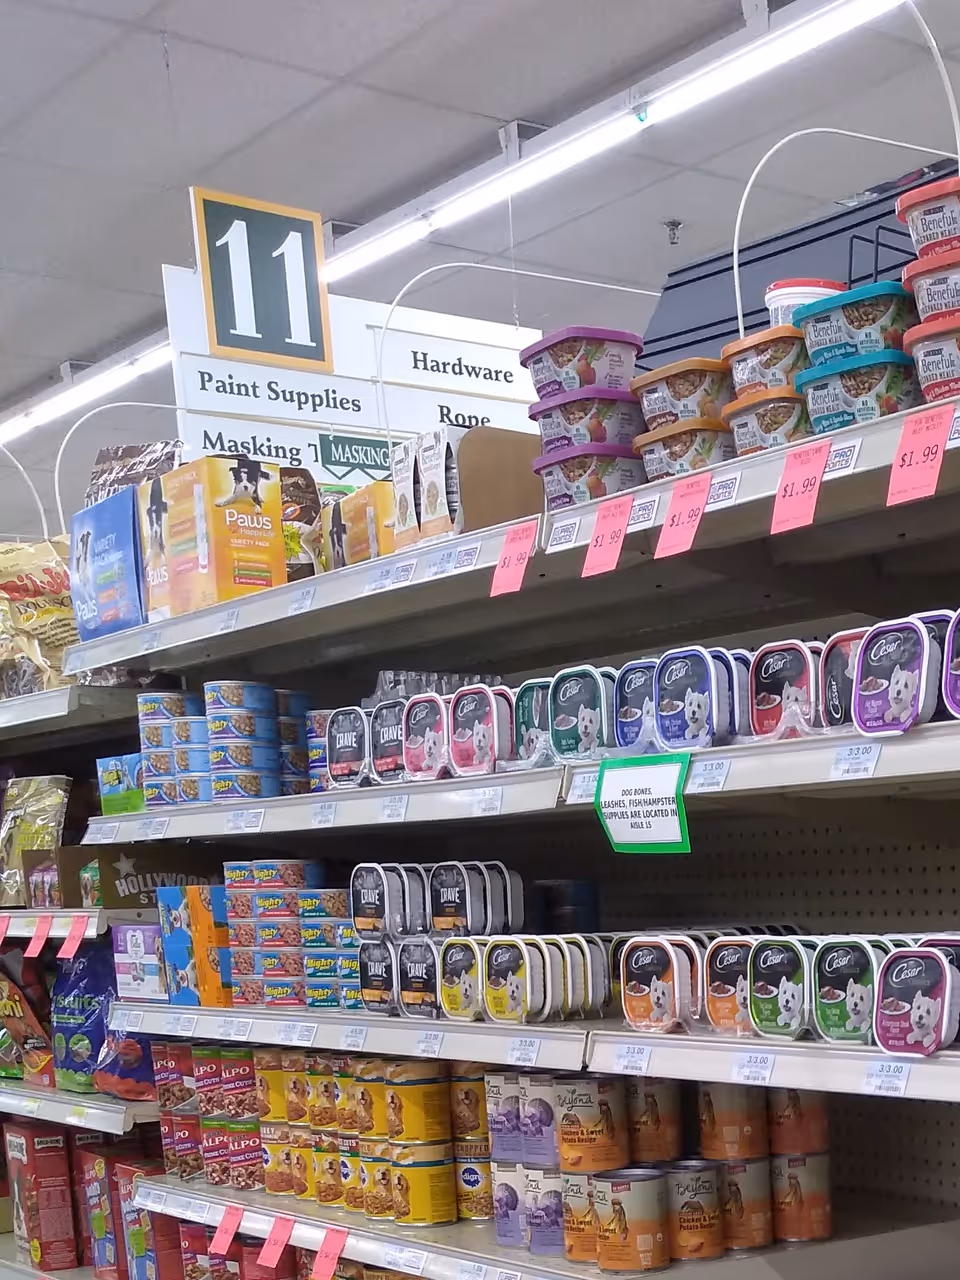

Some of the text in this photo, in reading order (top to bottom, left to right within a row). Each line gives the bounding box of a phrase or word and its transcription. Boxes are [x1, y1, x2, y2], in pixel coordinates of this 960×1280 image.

[216, 219, 317, 347] 11
[411, 351, 514, 384] Hardware
[198, 370, 362, 414] Paint Supplies
[202, 430, 302, 466] Masking
[899, 444, 939, 469] $1.99
[781, 476, 817, 499] $1.99
[225, 508, 272, 530] Paws
[870, 638, 901, 661] Cesar
[761, 657, 787, 678] Cesar
[847, 746, 872, 757] 3/3.00
[621, 789, 633, 797] DOG
[604, 811, 629, 820] SUPPLIES
[630, 810, 642, 819] ARE
[643, 808, 670, 819] LOCATED
[630, 821, 645, 829] AISLE
[825, 952, 850, 971] Cesar
[893, 965, 922, 983] Cesar
[747, 1056, 768, 1065] 3/3.00
[878, 1065, 904, 1074] 3/3.00
[222, 1065, 250, 1079] ALPO
[229, 1137, 260, 1151] ALPO
